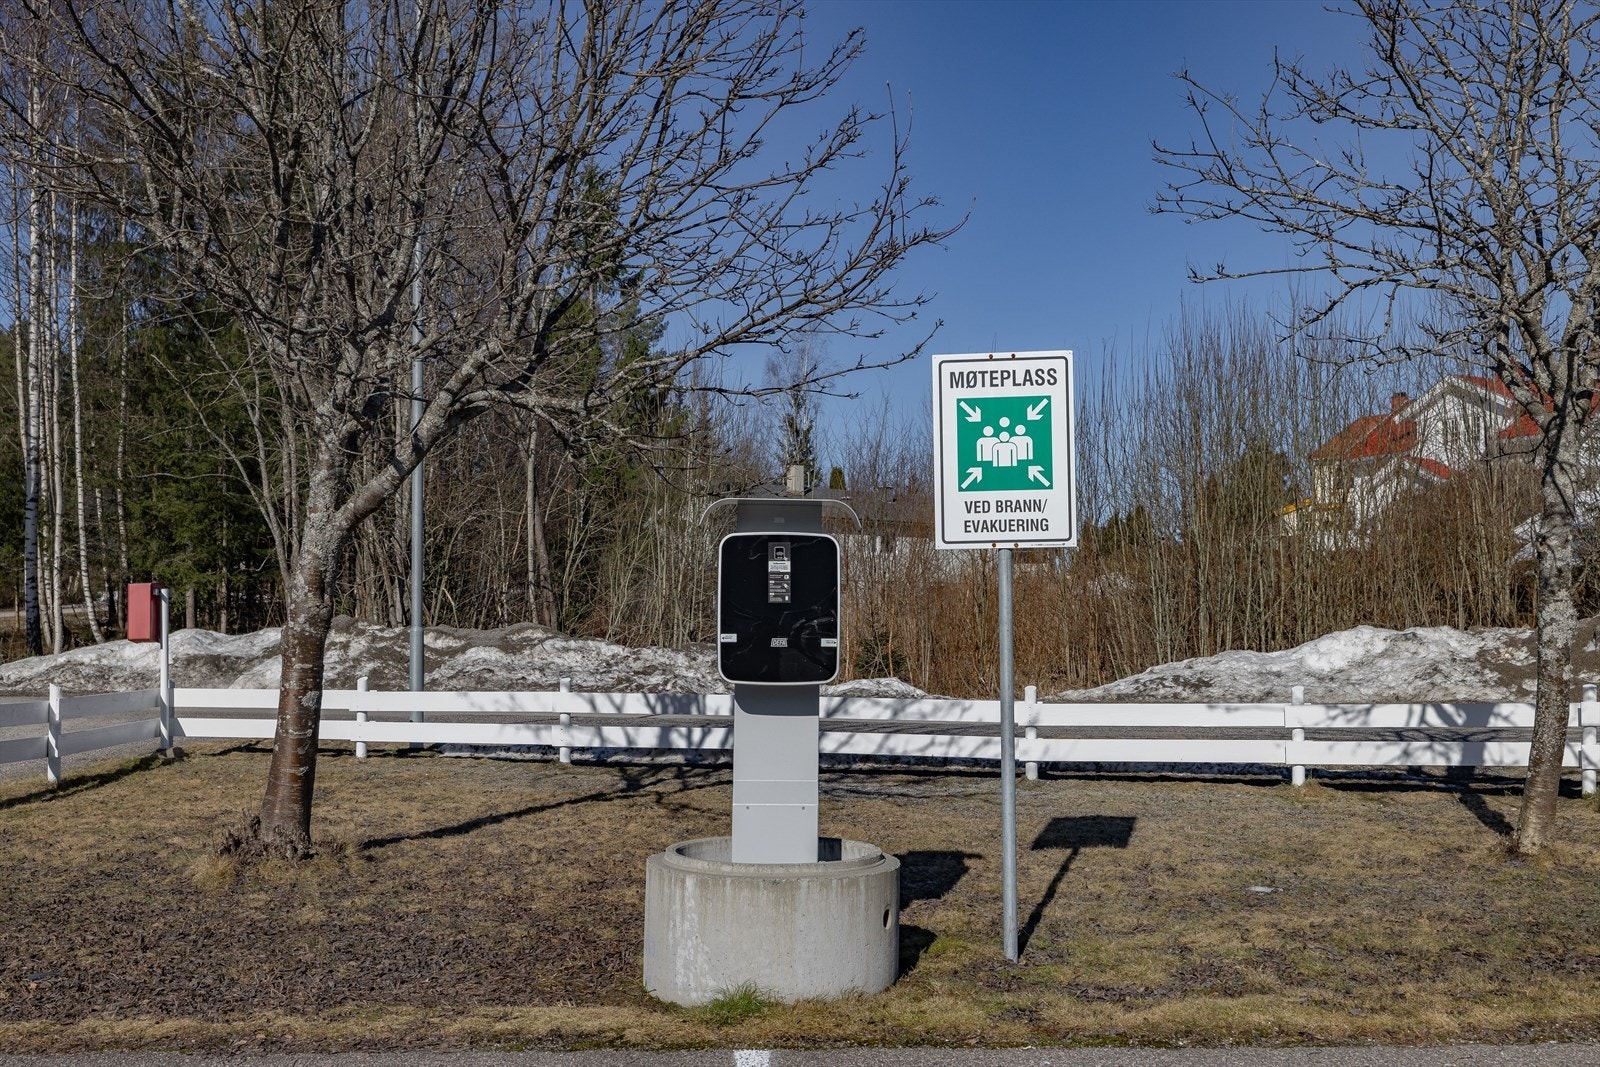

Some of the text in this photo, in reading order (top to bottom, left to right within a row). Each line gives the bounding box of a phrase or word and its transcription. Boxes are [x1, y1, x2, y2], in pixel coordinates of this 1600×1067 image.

[949, 368, 1058, 389] MØTEPLASS
[964, 498, 1048, 514] VED BRANN/
[964, 518, 1049, 533] EVAKUERING
